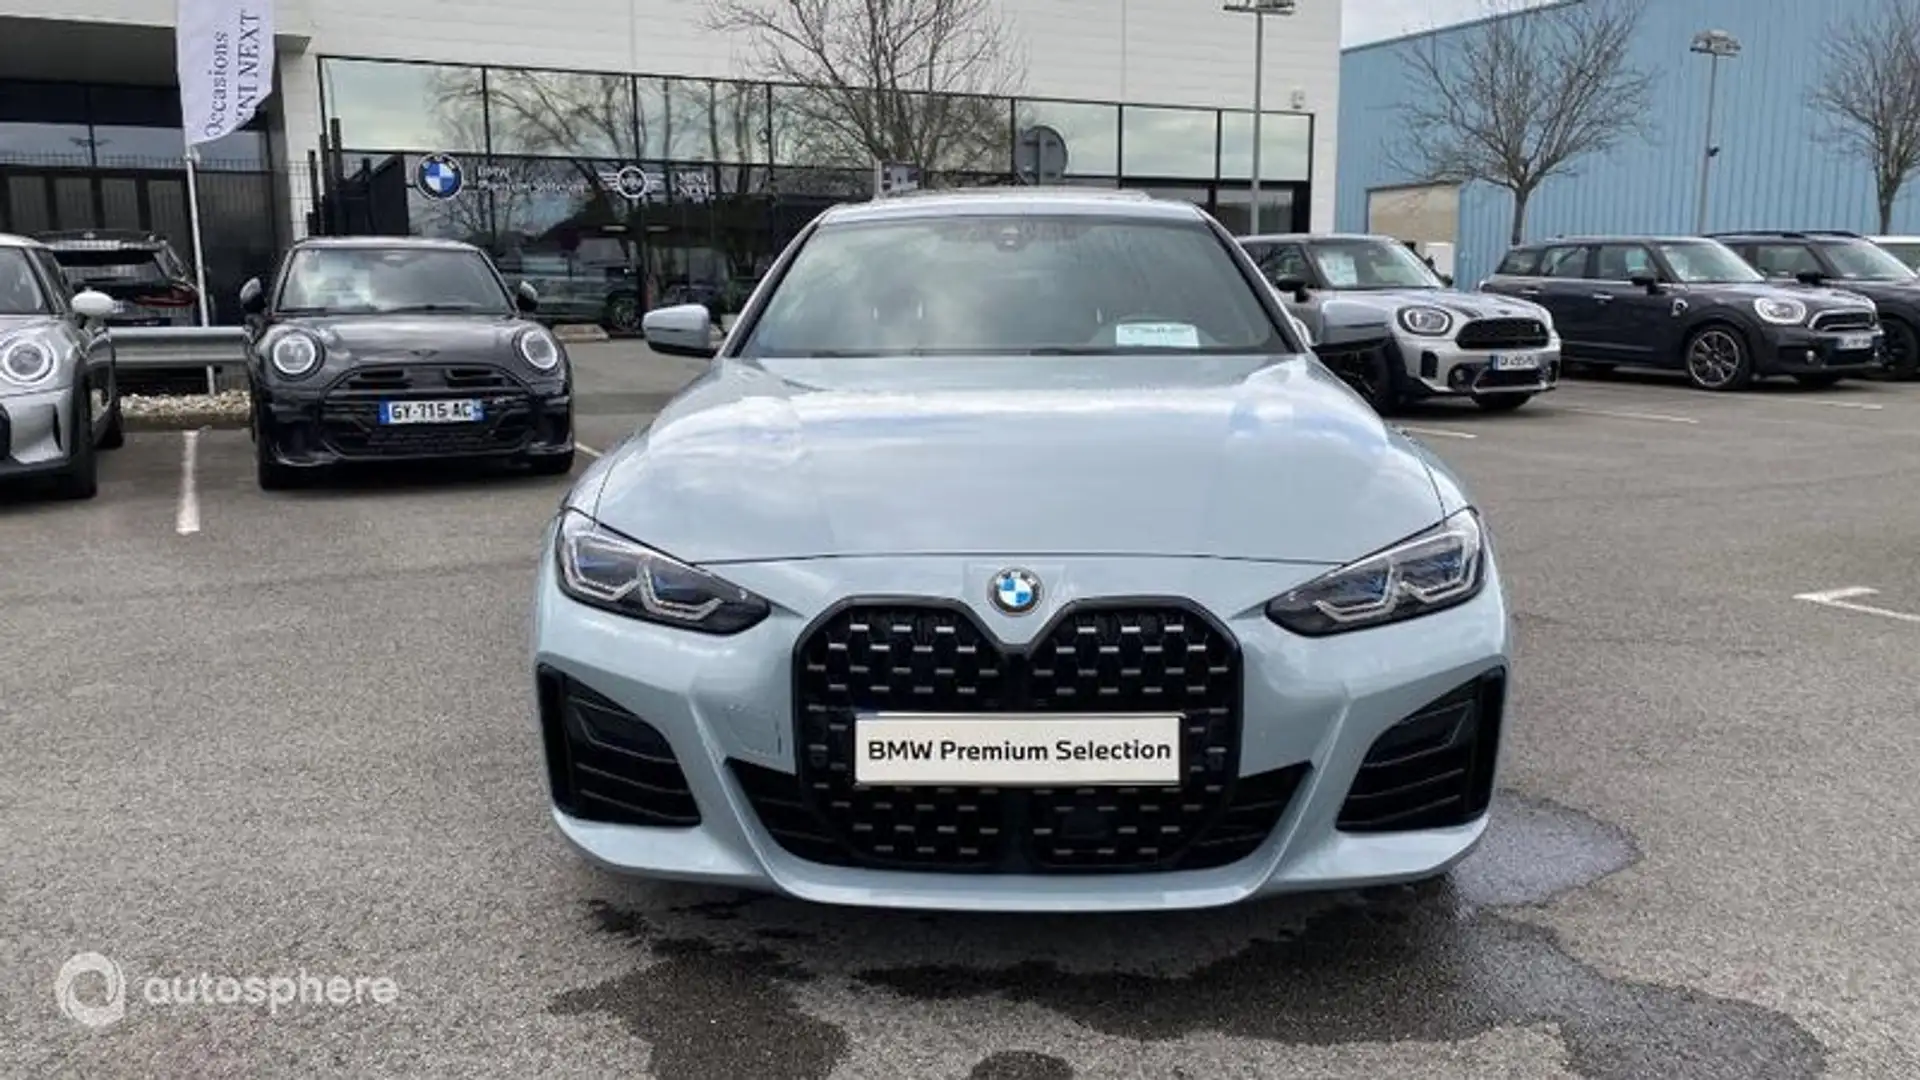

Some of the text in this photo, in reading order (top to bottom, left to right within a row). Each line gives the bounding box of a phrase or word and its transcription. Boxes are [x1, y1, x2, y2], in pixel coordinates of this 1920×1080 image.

[238, 8, 261, 78] NEXT
[205, 32, 229, 137] Occasions
[868, 739, 1171, 761] BMW Premium Selection
